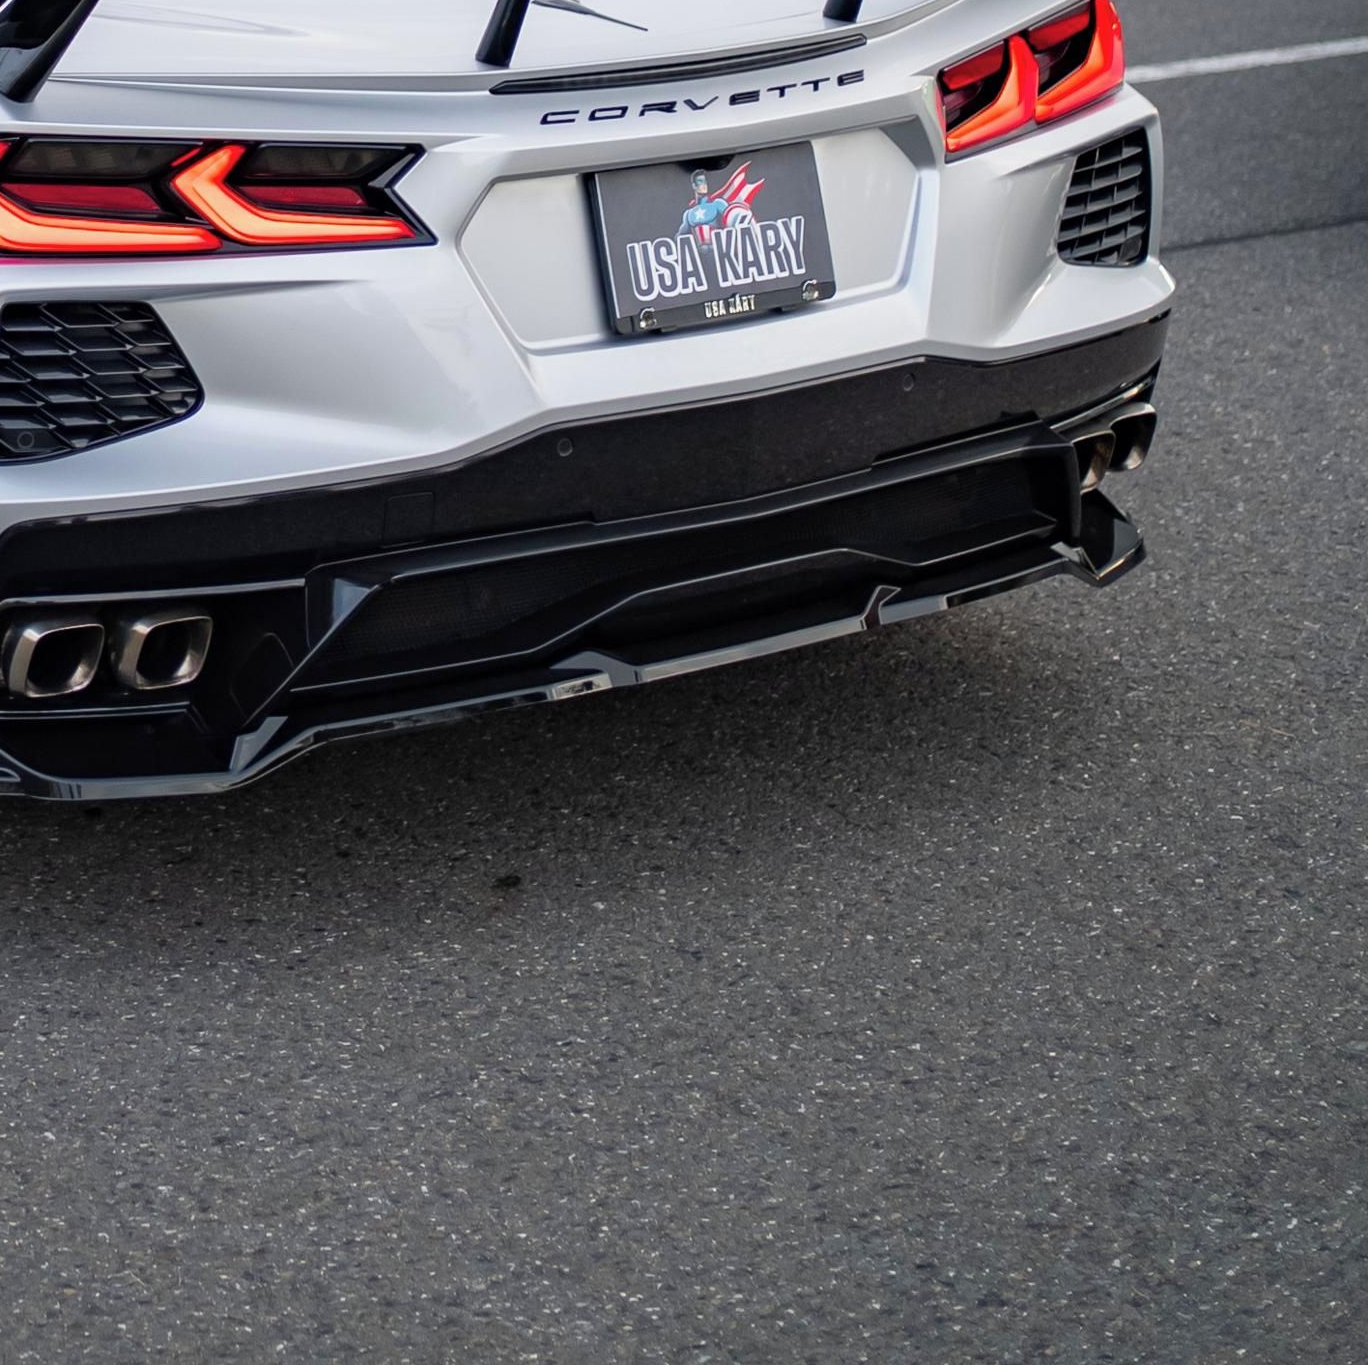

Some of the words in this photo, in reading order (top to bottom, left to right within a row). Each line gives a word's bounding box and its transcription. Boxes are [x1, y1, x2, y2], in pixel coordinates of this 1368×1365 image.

[540, 69, 864, 125] CORVETTE
[626, 234, 708, 301] USA
[711, 211, 806, 288] KÁRY
[704, 299, 727, 318] USA
